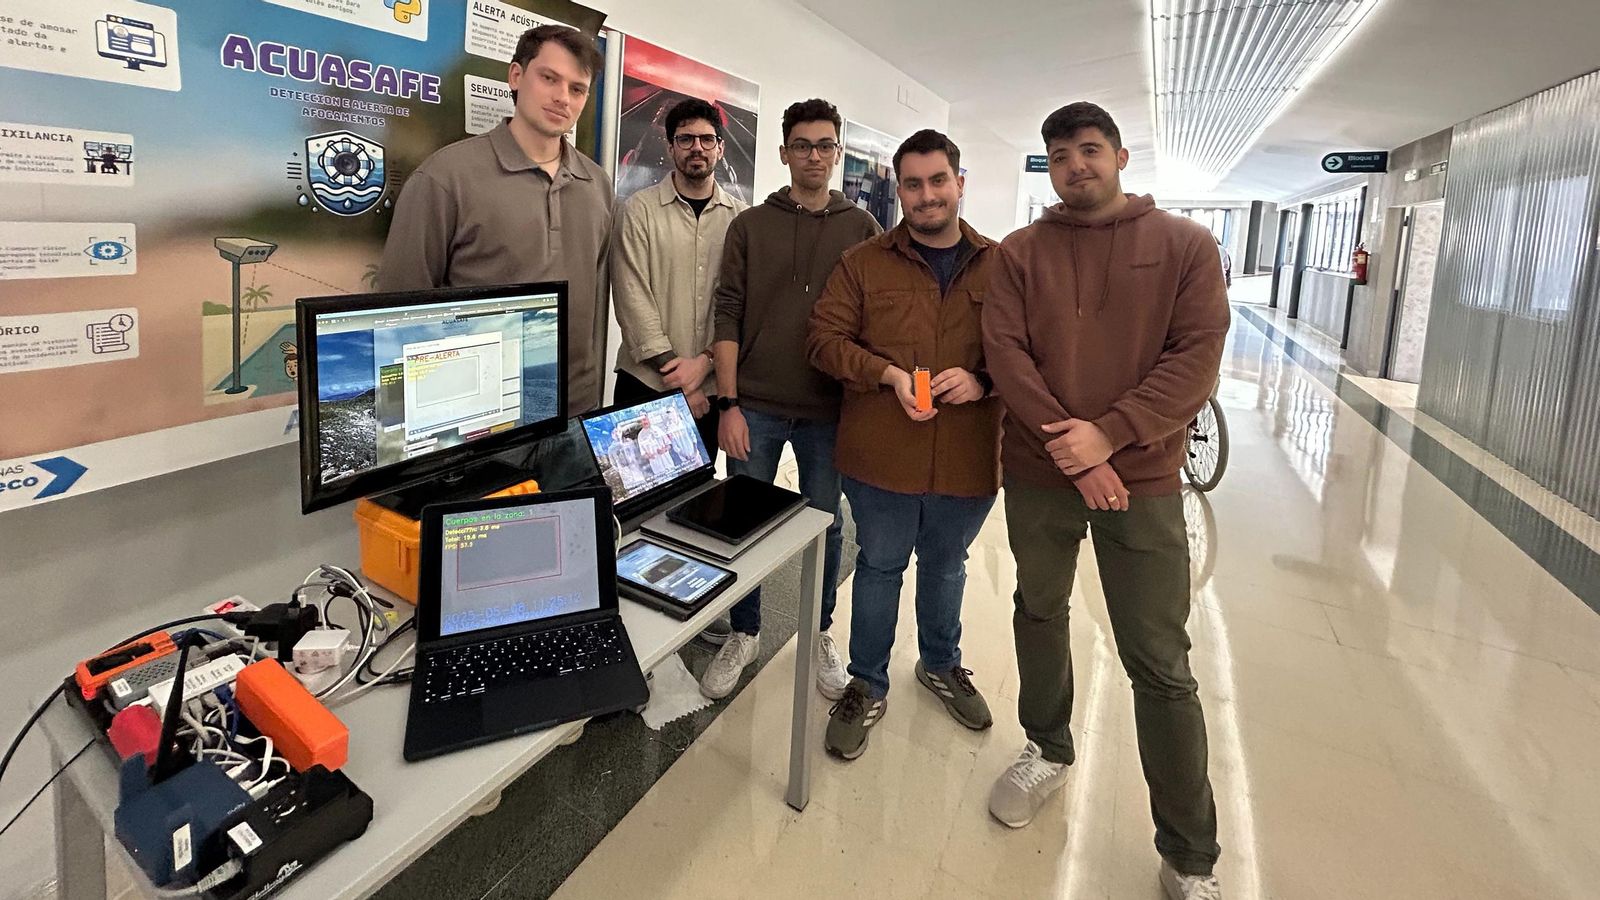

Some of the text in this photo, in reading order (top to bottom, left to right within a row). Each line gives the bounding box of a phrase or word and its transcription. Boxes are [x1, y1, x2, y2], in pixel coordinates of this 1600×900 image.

[473, 1, 506, 20] ALERTA
[20, 18, 34, 27] de
[40, 22, 78, 34] amosar
[34, 30, 47, 40] da
[7, 37, 54, 51] alertas
[221, 34, 441, 103] ACUASAFE
[342, 98, 351, 109] E
[352, 99, 395, 115] ALERTA
[395, 106, 410, 117] DE
[302, 107, 385, 126] AFOGAMENTOS
[1, 128, 74, 143] IXILANCIA
[416, 350, 461, 363] PRE-ALERTA
